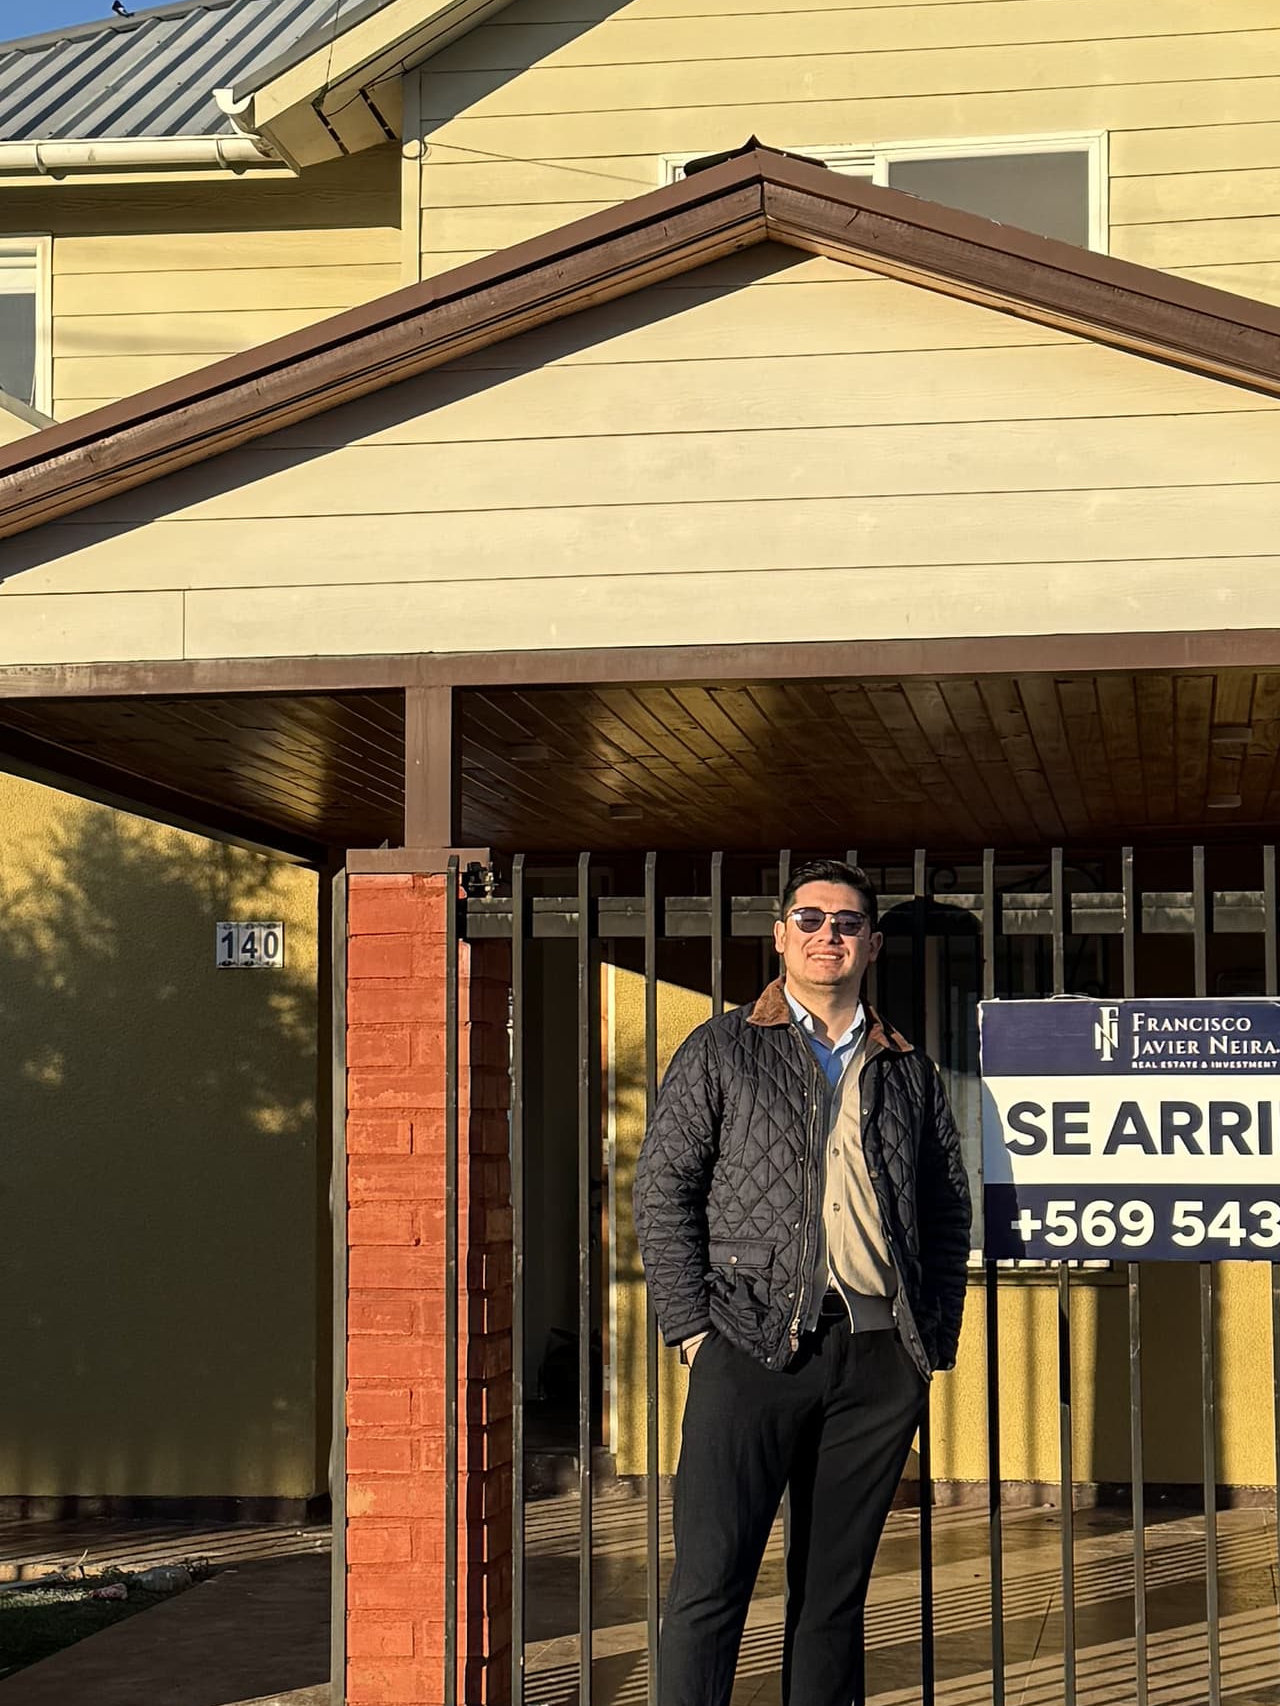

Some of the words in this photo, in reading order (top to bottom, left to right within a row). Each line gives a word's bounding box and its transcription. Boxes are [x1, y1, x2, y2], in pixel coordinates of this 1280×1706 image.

[221, 931, 279, 959] 140
[1132, 1013, 1251, 1032] FRANCISCO
[1132, 1036, 1200, 1059] JAVIER
[1131, 1061, 1157, 1069] REAL
[1161, 1061, 1198, 1069] ESTATE
[1201, 1061, 1208, 1069] &
[1211, 1061, 1277, 1069] INVESTMENT
[1006, 1101, 1090, 1156] SE
[1011, 1200, 1155, 1248] +569
